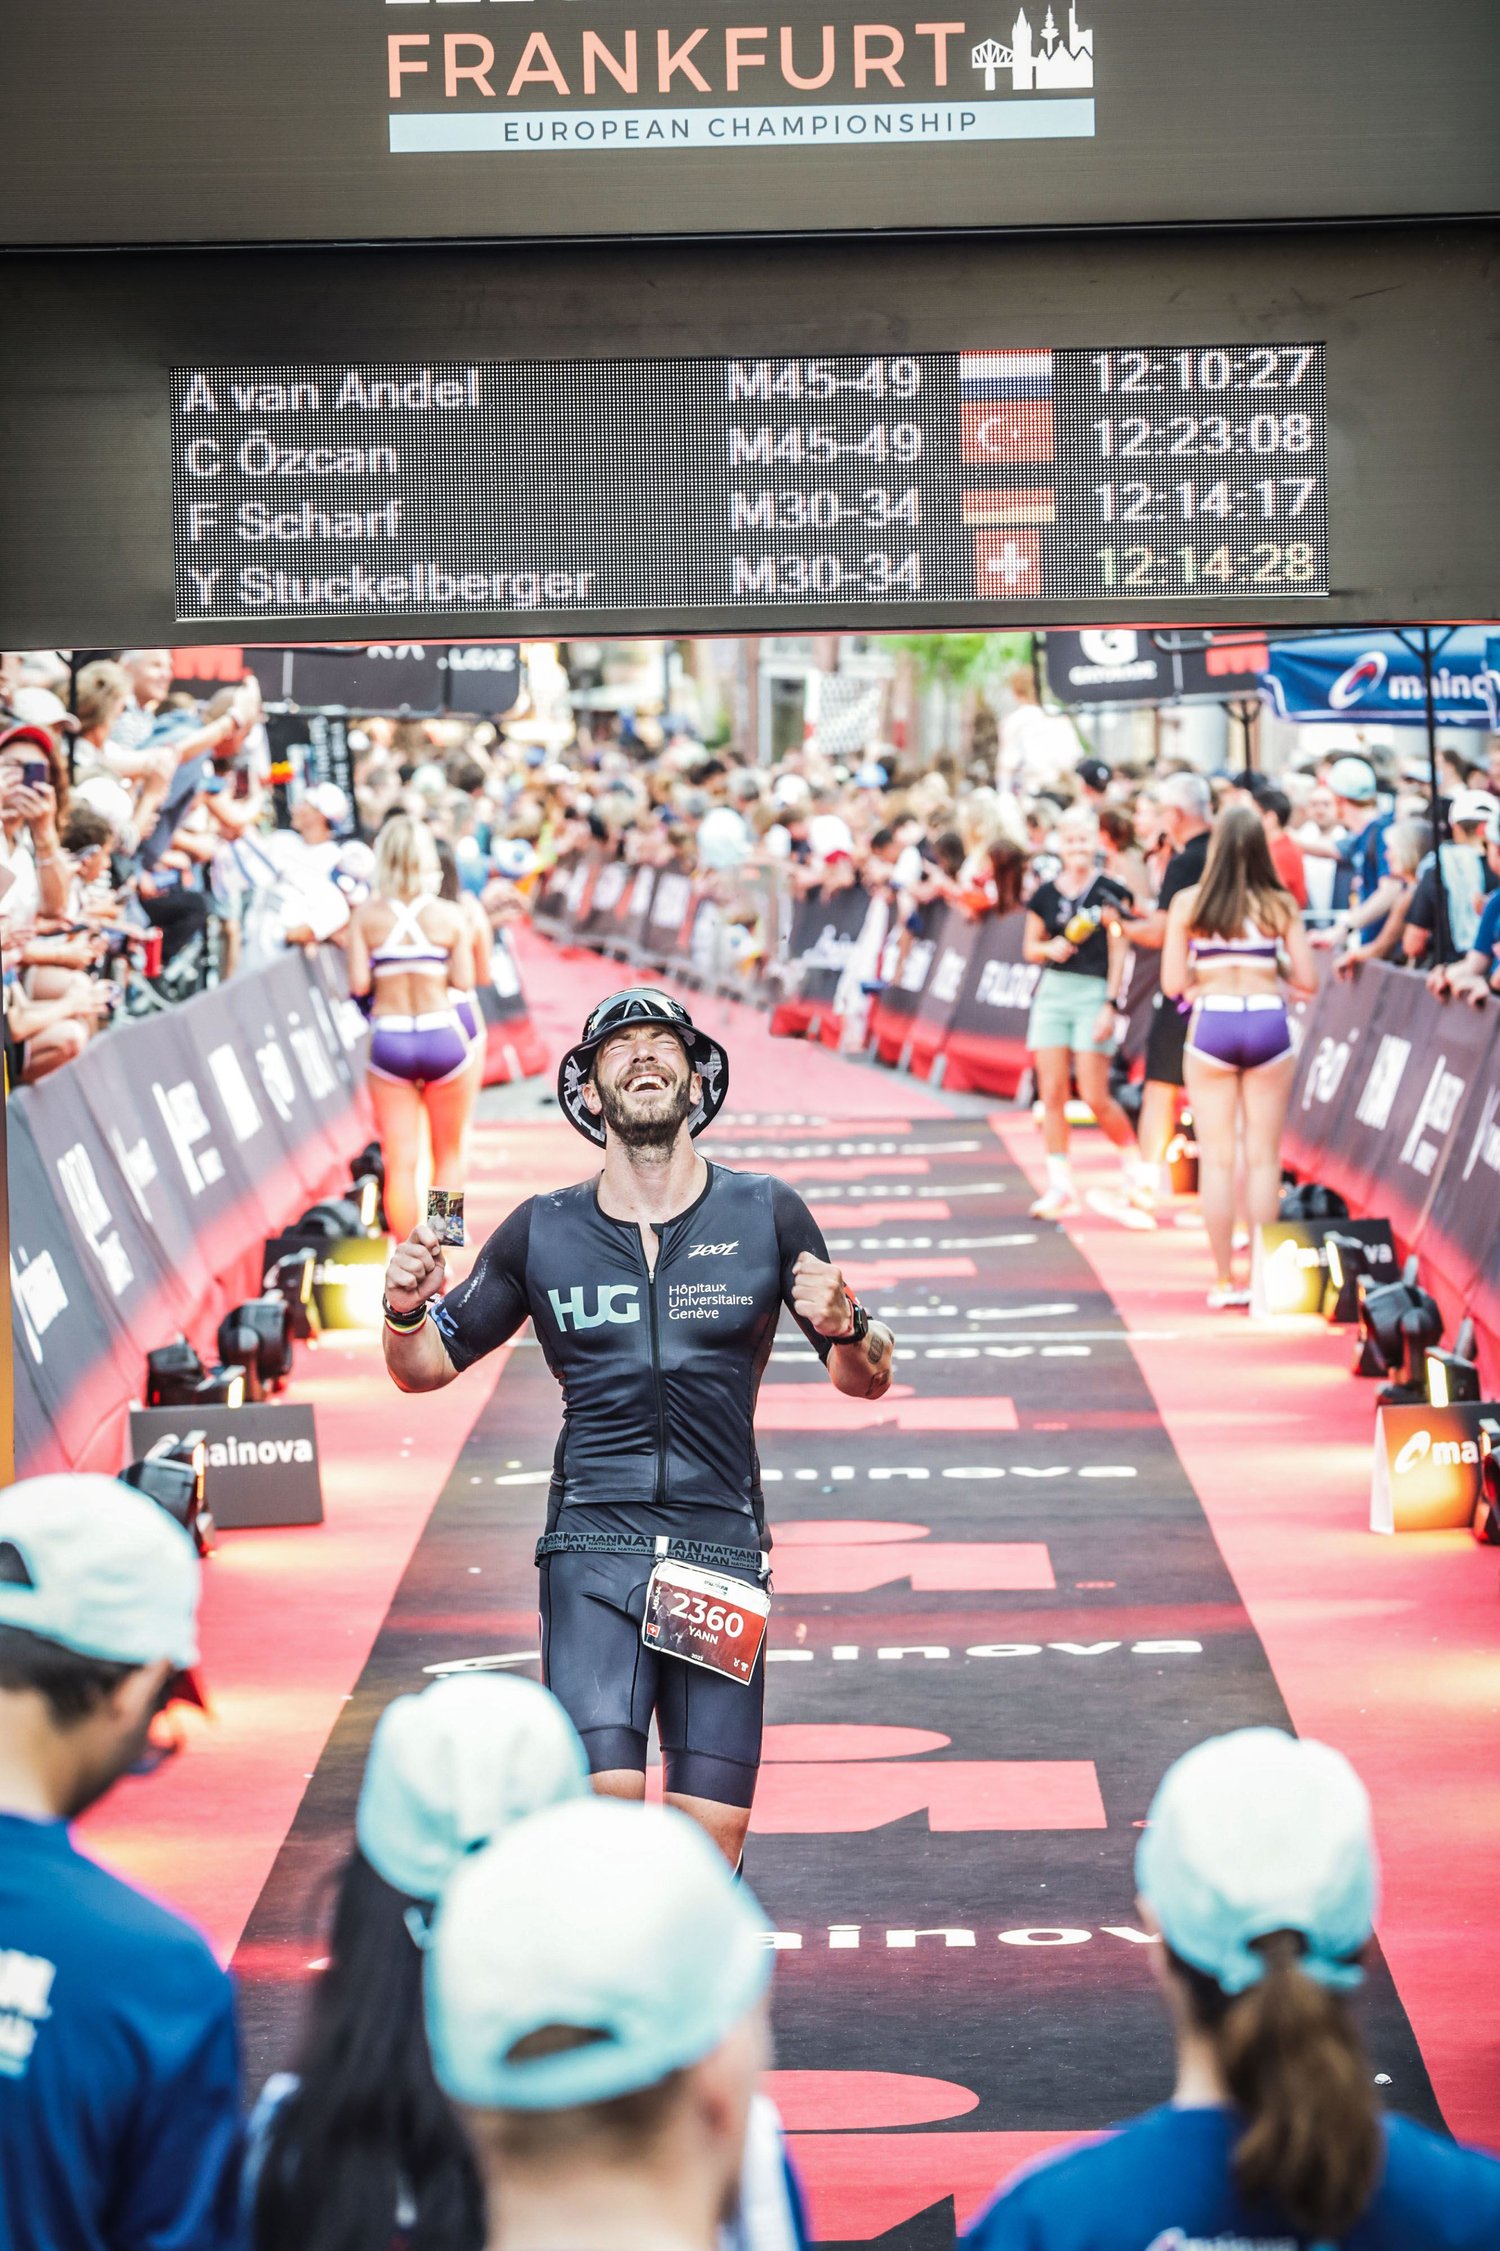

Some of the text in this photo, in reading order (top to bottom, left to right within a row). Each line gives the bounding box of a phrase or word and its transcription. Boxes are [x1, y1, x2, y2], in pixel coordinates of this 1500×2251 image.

[388, 21, 967, 99] FRANKFURT
[503, 111, 978, 143] EUROPEAN CHAMPIONSHIP
[182, 349, 1313, 412] A van Andel M45-49 12:10:27
[184, 415, 1314, 477] C Özcan M45-49 12:23:08
[187, 478, 1317, 543] F Scharf M30-34 12:14:17
[188, 543, 1316, 608] Y Stuckelberger M30-34 12:14:28
[668, 1283, 727, 1298] Hôpitaux
[668, 1293, 754, 1308] Universitaires
[548, 1284, 640, 1332] HUG
[668, 1307, 719, 1320] Genève
[205, 1435, 314, 1468] ainova
[674, 1550, 730, 1566] NATHAN
[704, 1544, 756, 1560] NATHAN
[670, 1592, 744, 1638] 2360
[688, 1625, 719, 1646] YANN
